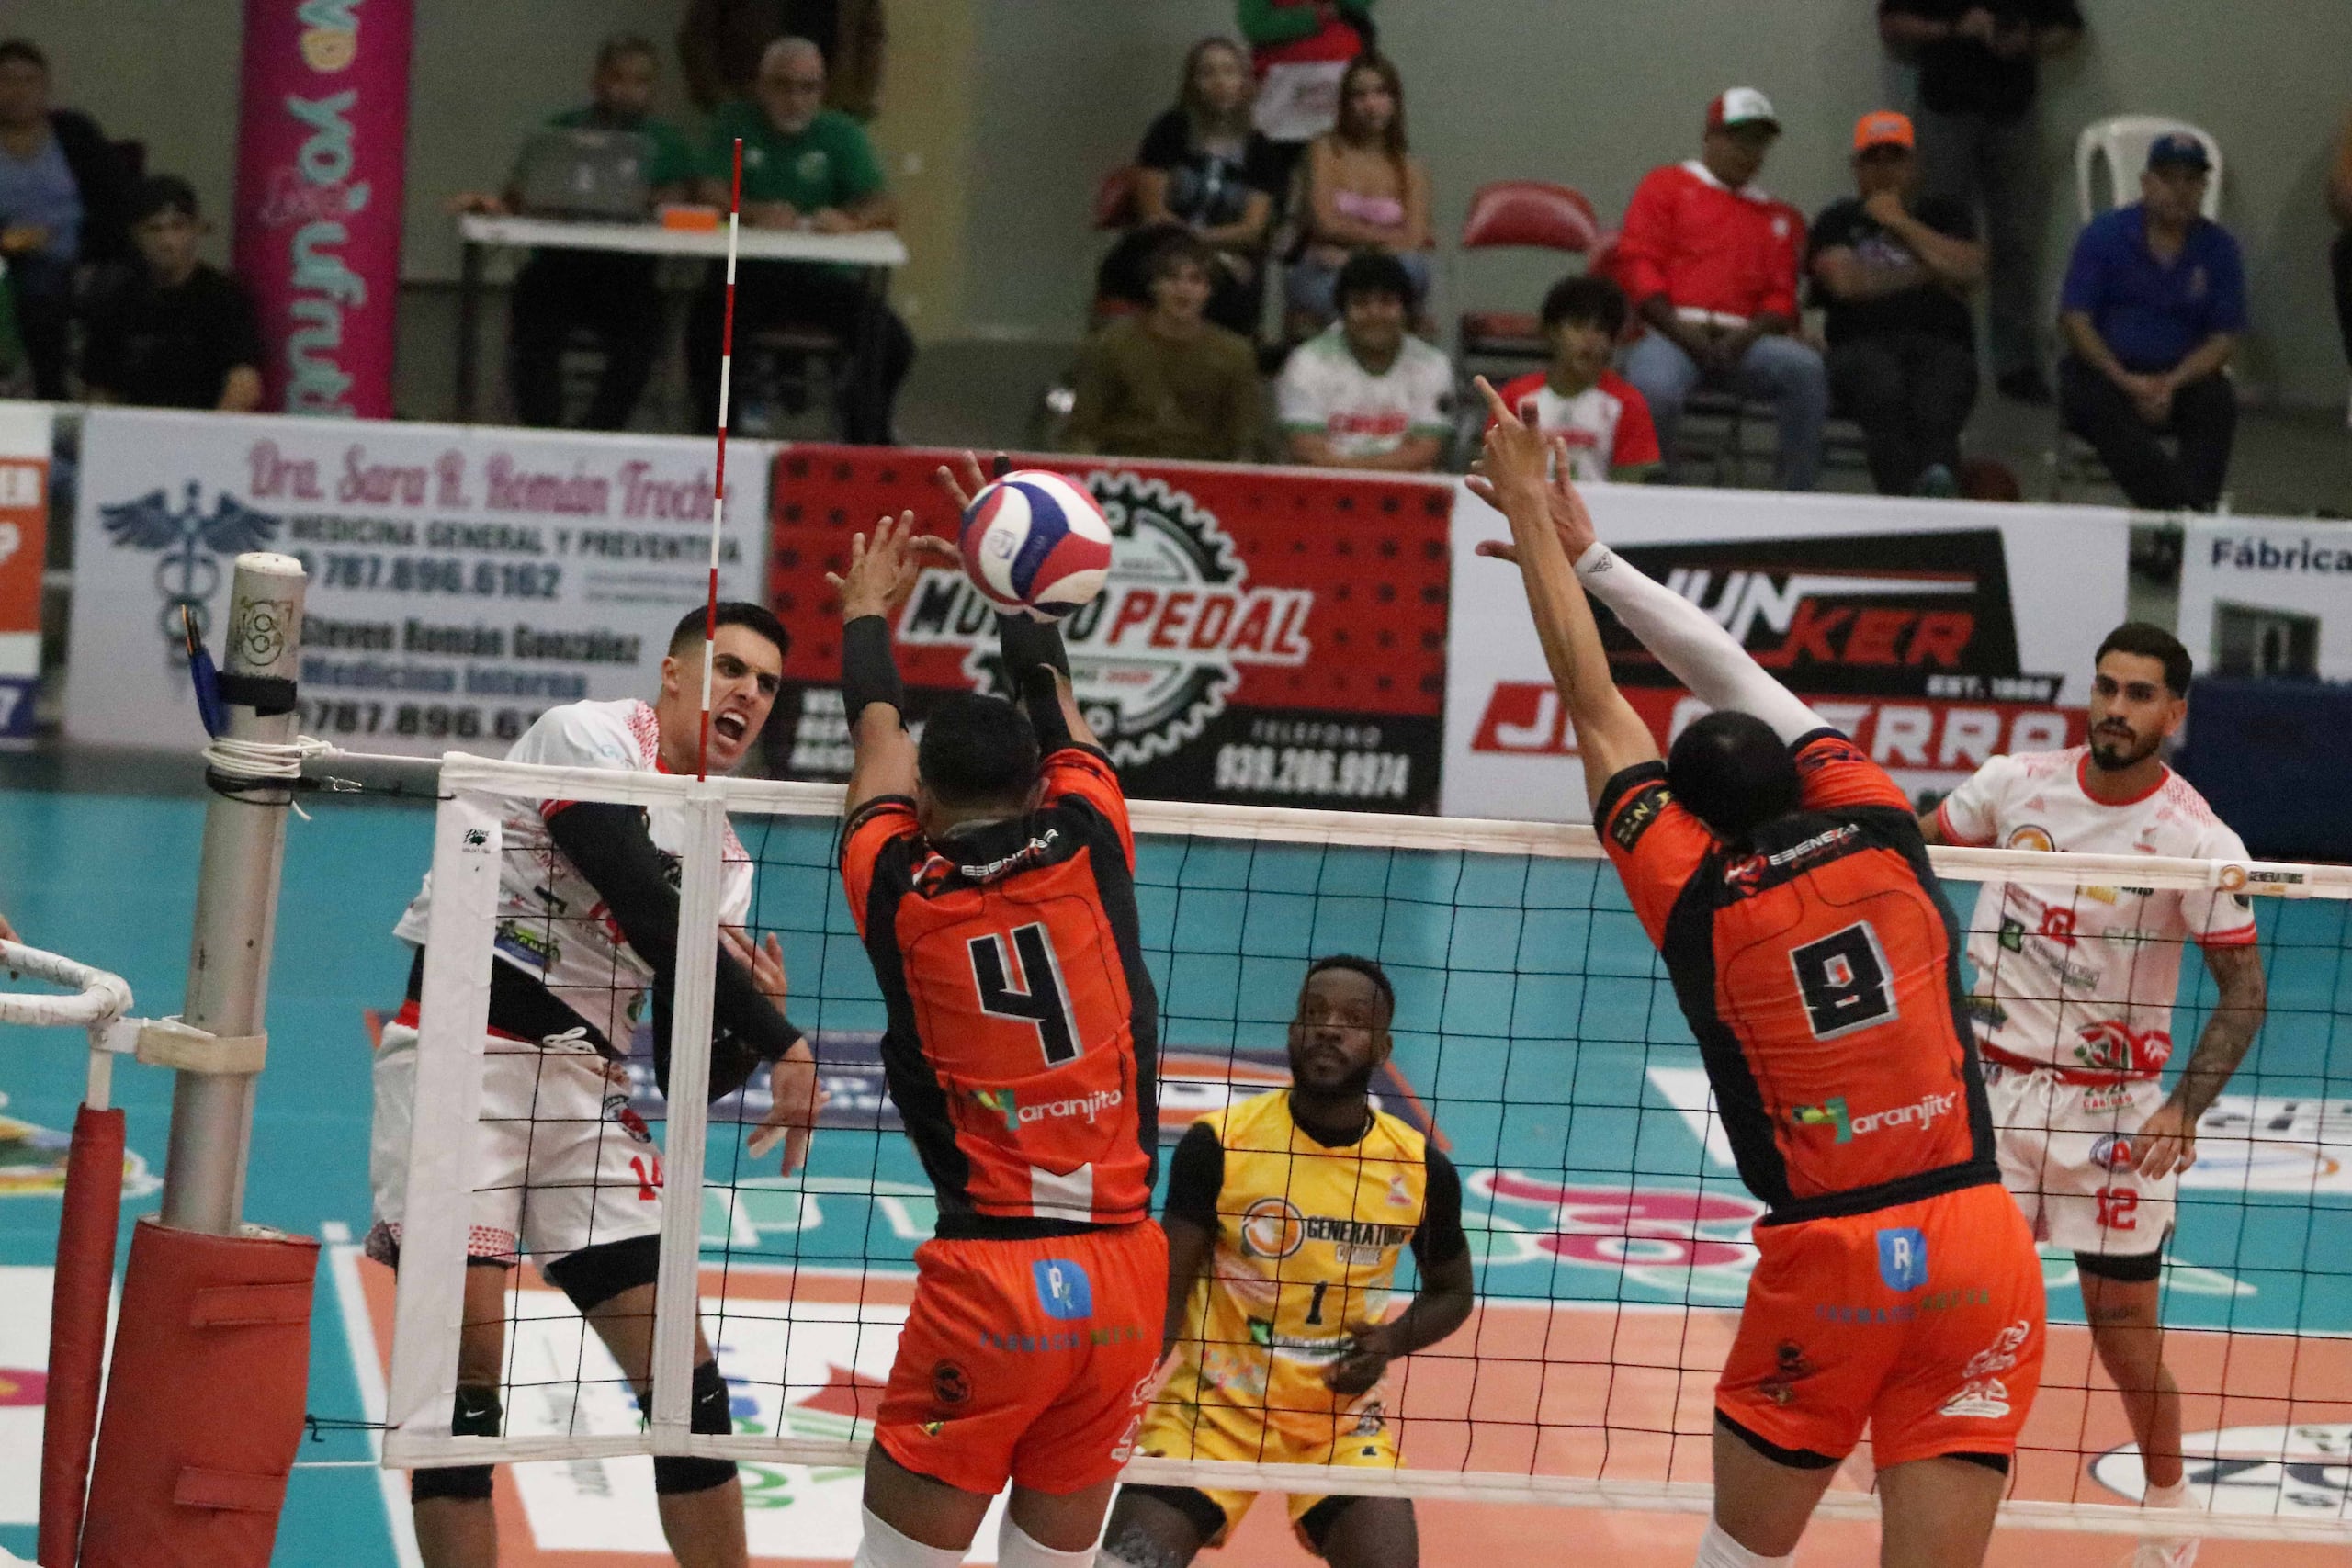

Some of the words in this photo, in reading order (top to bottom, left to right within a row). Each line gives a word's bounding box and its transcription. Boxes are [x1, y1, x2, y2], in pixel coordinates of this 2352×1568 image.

[288, 514, 416, 546] MEDICINA
[426, 521, 544, 552] GENERAL
[966, 920, 1085, 1069] 4
[2095, 1186, 2139, 1231] 12
[1305, 1280, 1329, 1325] 1
